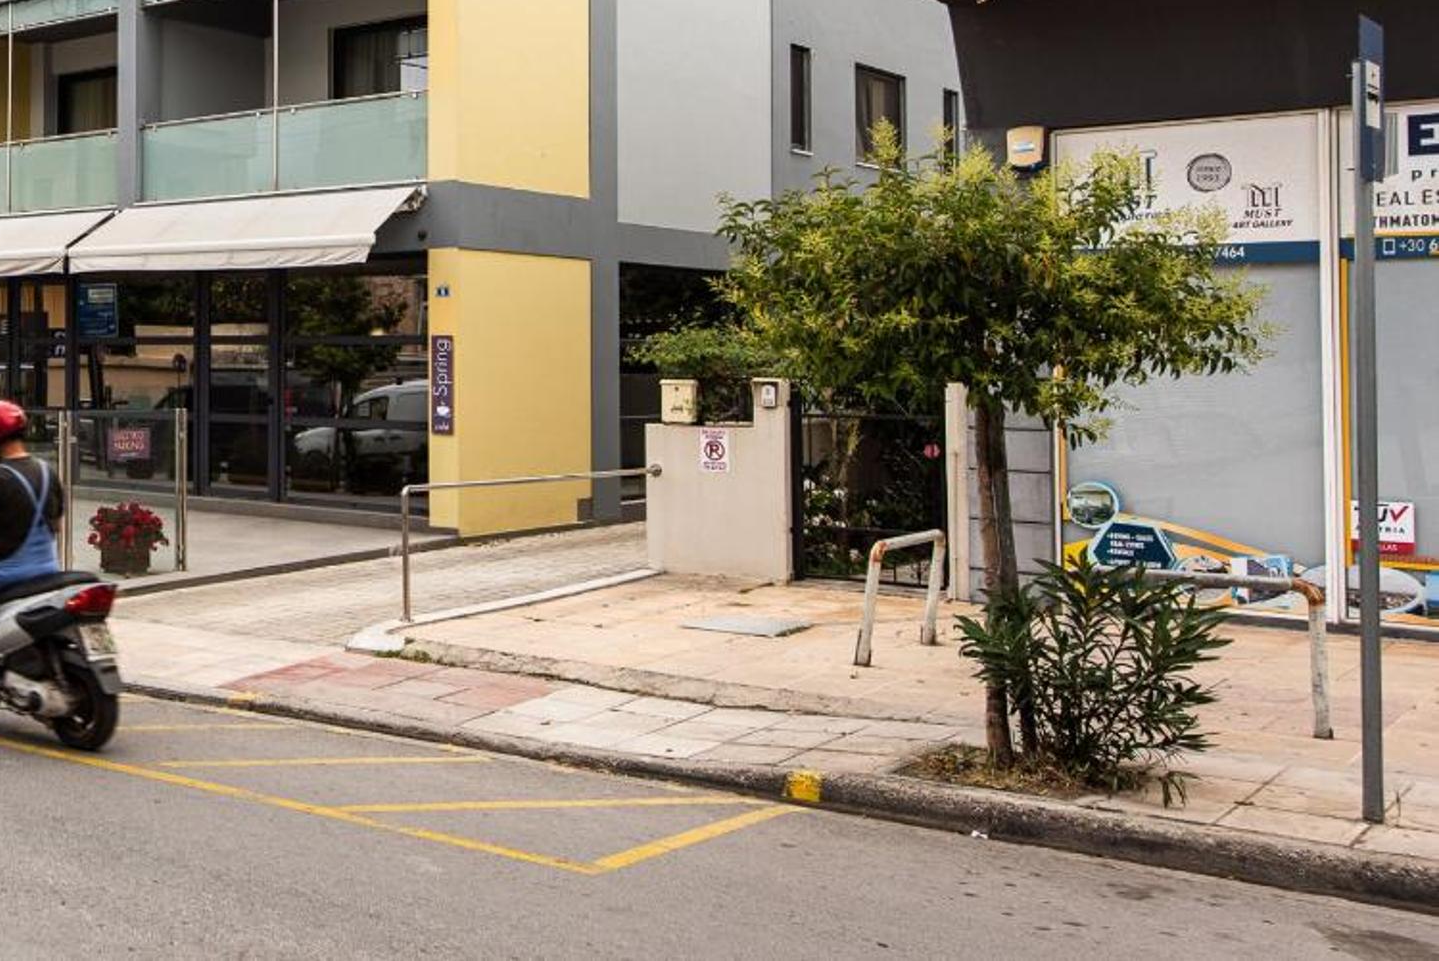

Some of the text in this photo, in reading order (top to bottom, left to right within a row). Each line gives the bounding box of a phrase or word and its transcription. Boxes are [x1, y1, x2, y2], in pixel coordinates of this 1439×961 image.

[1376, 190, 1414, 207] EAL
[1242, 208, 1283, 219] MUST
[1232, 219, 1294, 229] ART GALLERY
[433, 339, 452, 397] Spring
